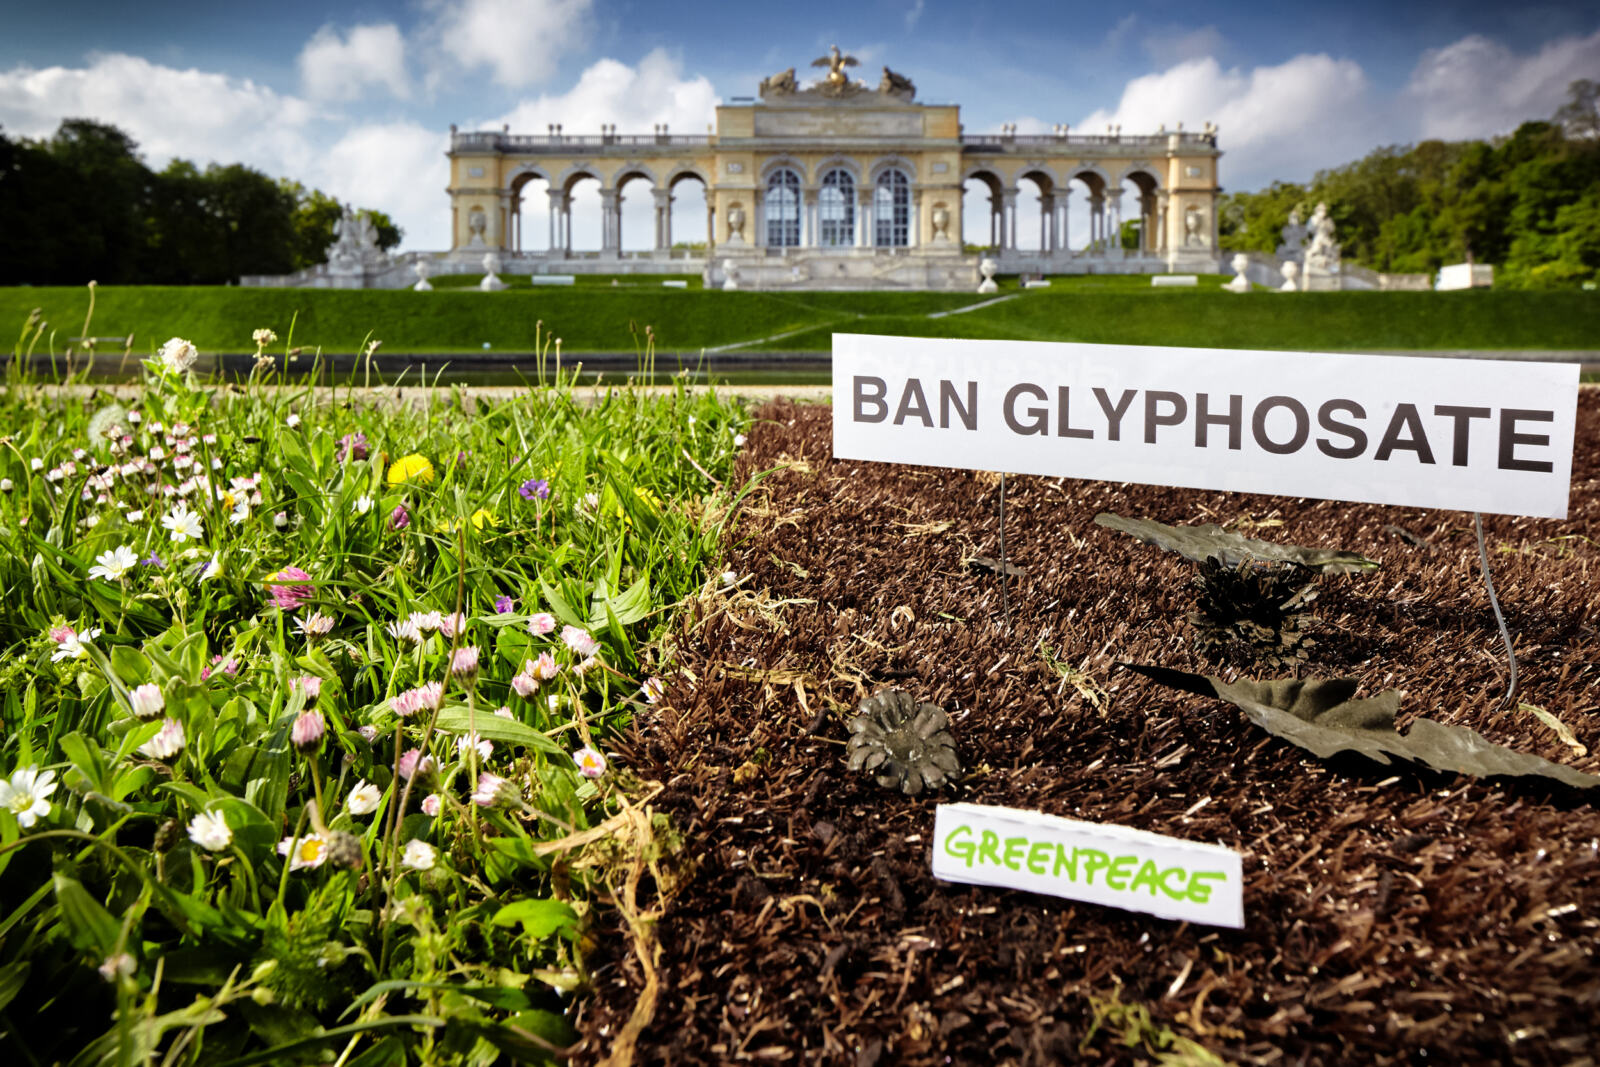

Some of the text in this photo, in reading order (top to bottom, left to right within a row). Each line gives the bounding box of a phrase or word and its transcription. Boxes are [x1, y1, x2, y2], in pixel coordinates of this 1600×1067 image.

[853, 375, 1555, 473] BAN GLYPHOSATE
[944, 825, 1227, 904] GREENPEACE
